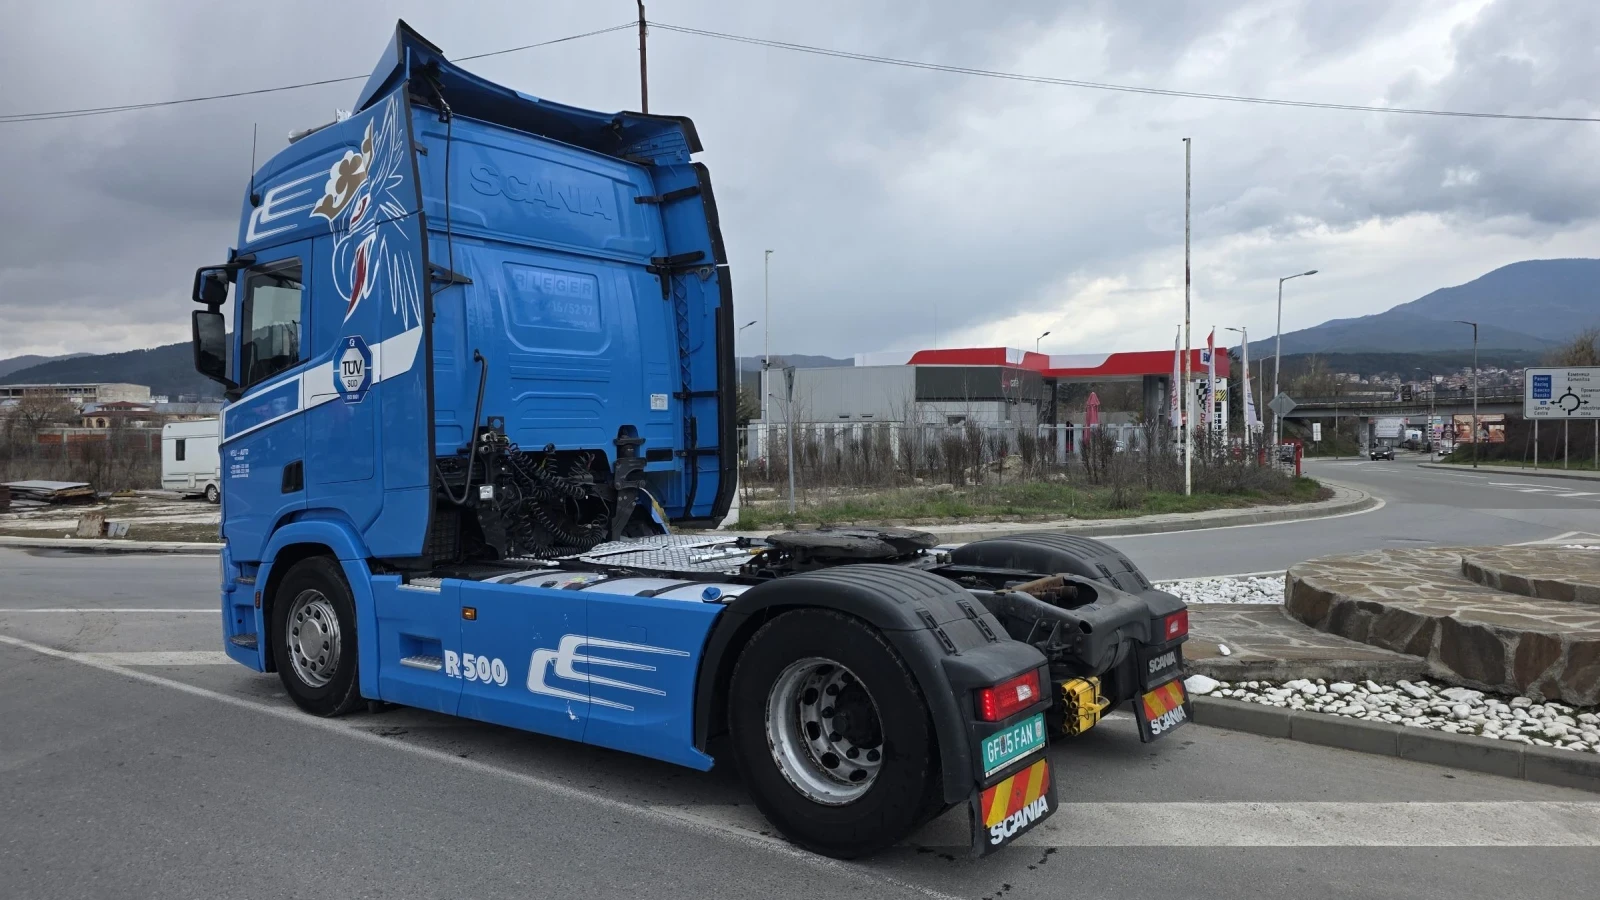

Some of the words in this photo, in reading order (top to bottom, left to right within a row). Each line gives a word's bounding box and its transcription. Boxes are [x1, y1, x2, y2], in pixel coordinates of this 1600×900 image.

[469, 162, 612, 221] SCANIA
[444, 650, 462, 679] R
[462, 652, 509, 687] 500
[1149, 651, 1176, 674] SCANIA
[1151, 705, 1187, 735] SCANIA
[990, 794, 1049, 845] SCANIA
